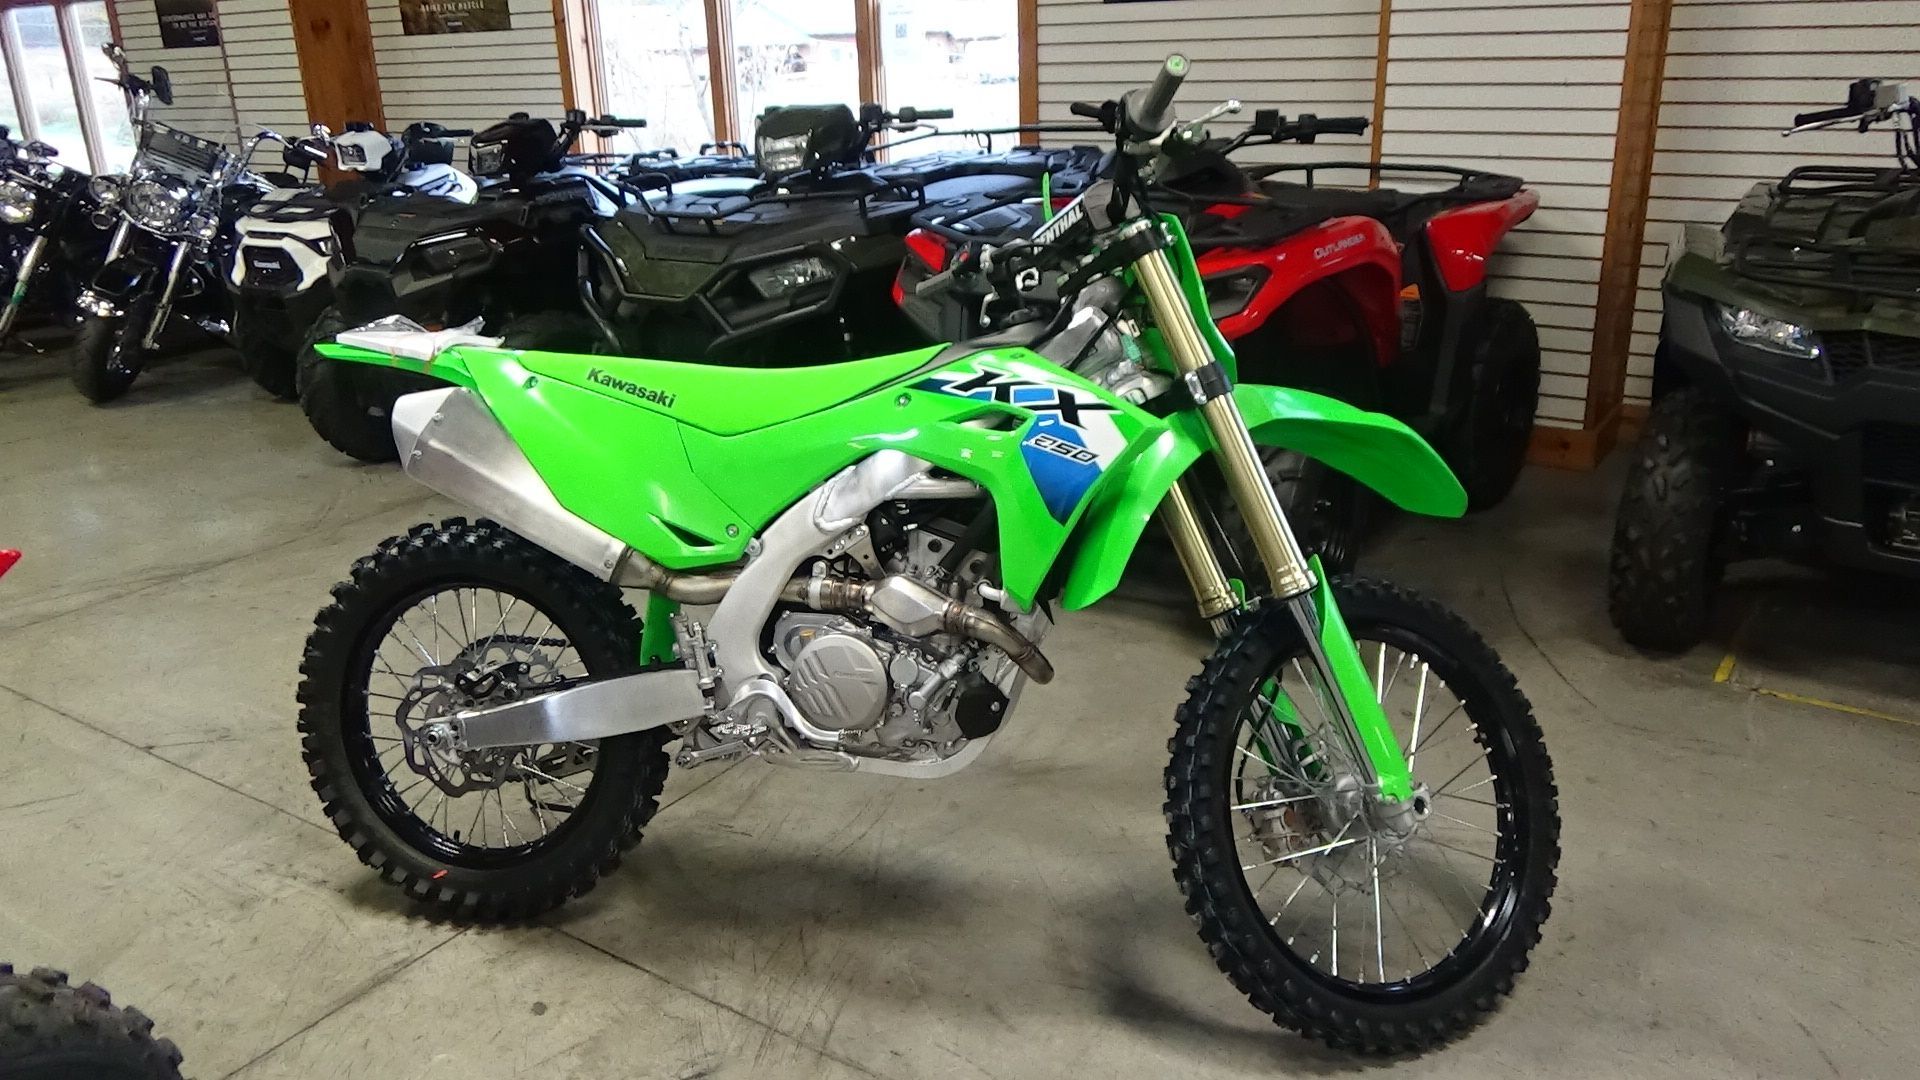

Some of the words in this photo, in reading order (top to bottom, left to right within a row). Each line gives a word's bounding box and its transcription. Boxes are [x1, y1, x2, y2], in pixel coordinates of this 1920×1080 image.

[586, 366, 677, 409] Kawasaki
[947, 366, 1121, 432] KX
[1032, 434, 1101, 465] 250
